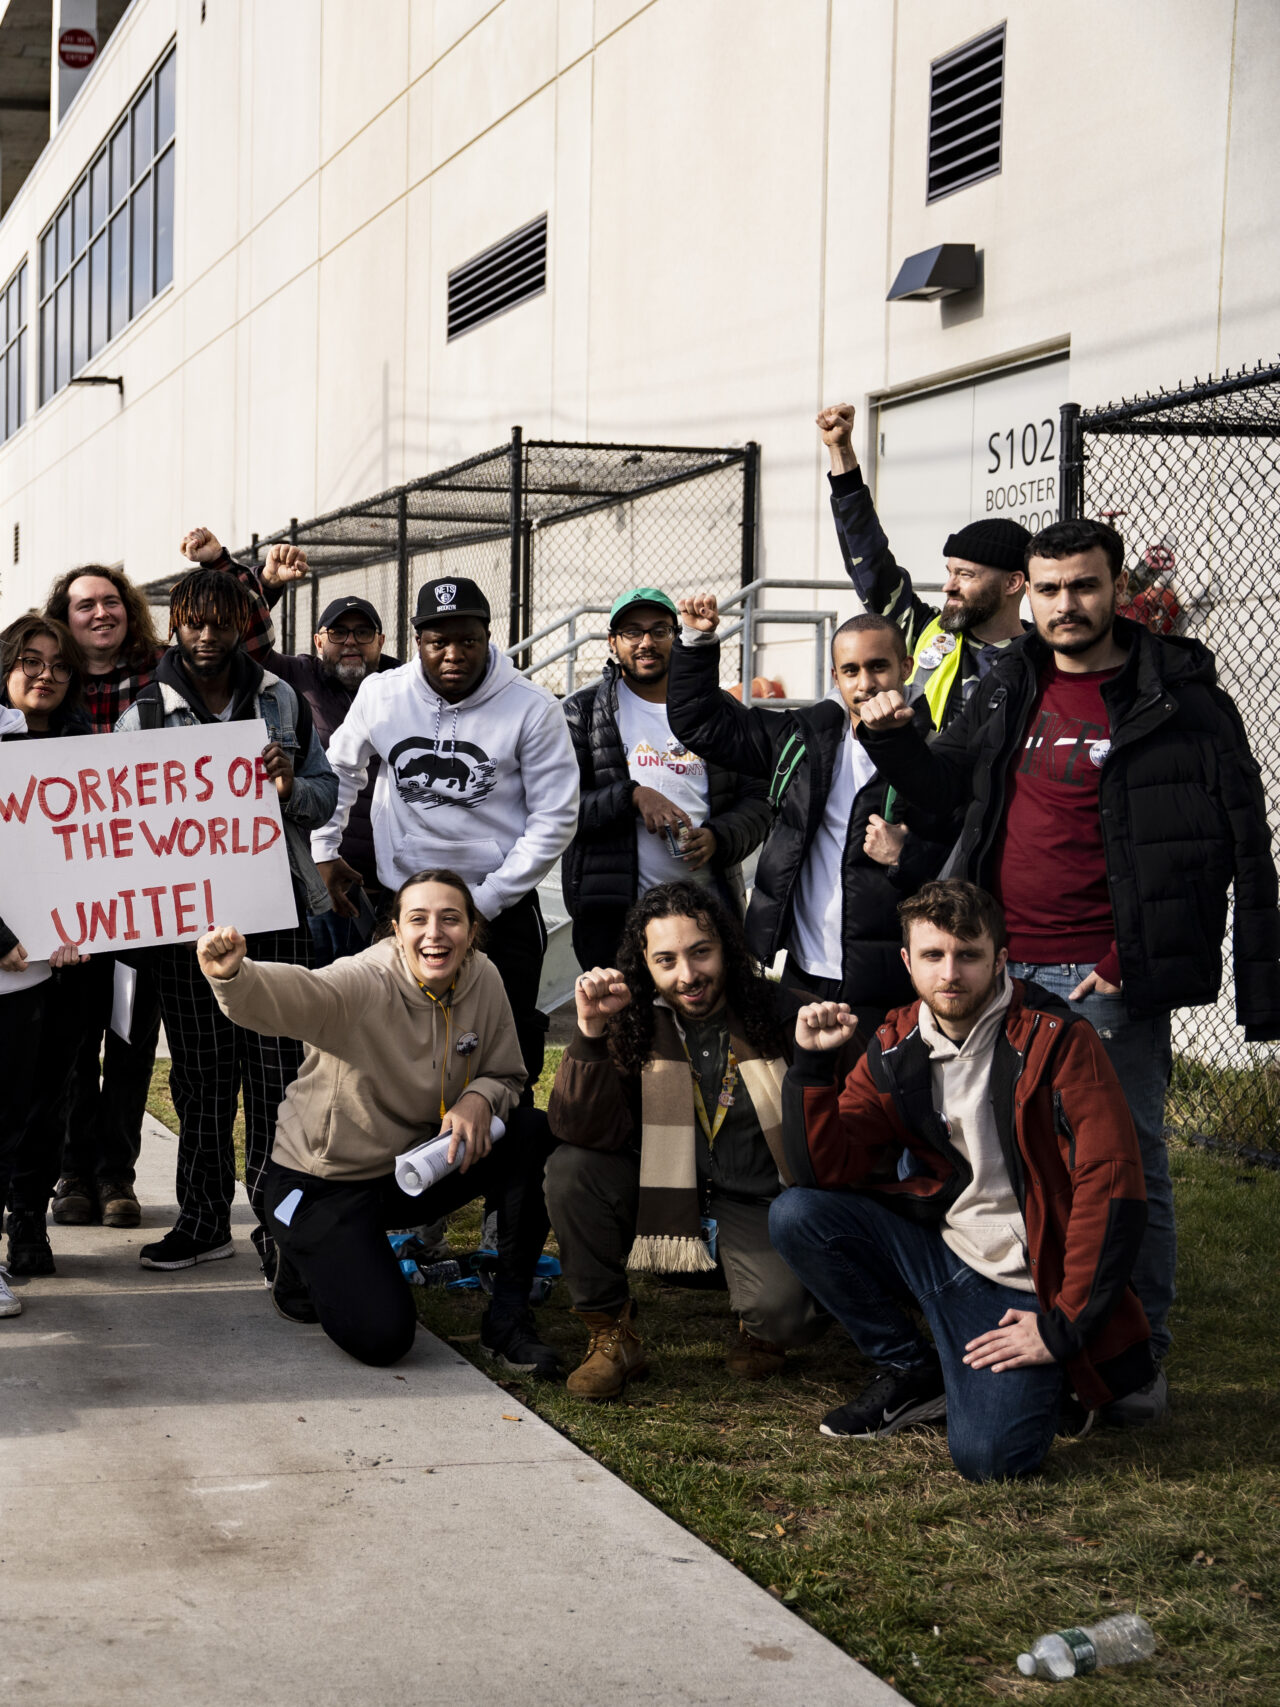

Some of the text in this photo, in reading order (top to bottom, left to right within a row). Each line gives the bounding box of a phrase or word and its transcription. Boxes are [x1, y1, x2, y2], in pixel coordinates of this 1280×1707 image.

[987, 418, 1055, 474] S102
[986, 477, 1055, 512] BOOSTER
[227, 756, 271, 801] OF
[51, 816, 282, 861] THE WORLD
[50, 879, 215, 948] UNITE!
